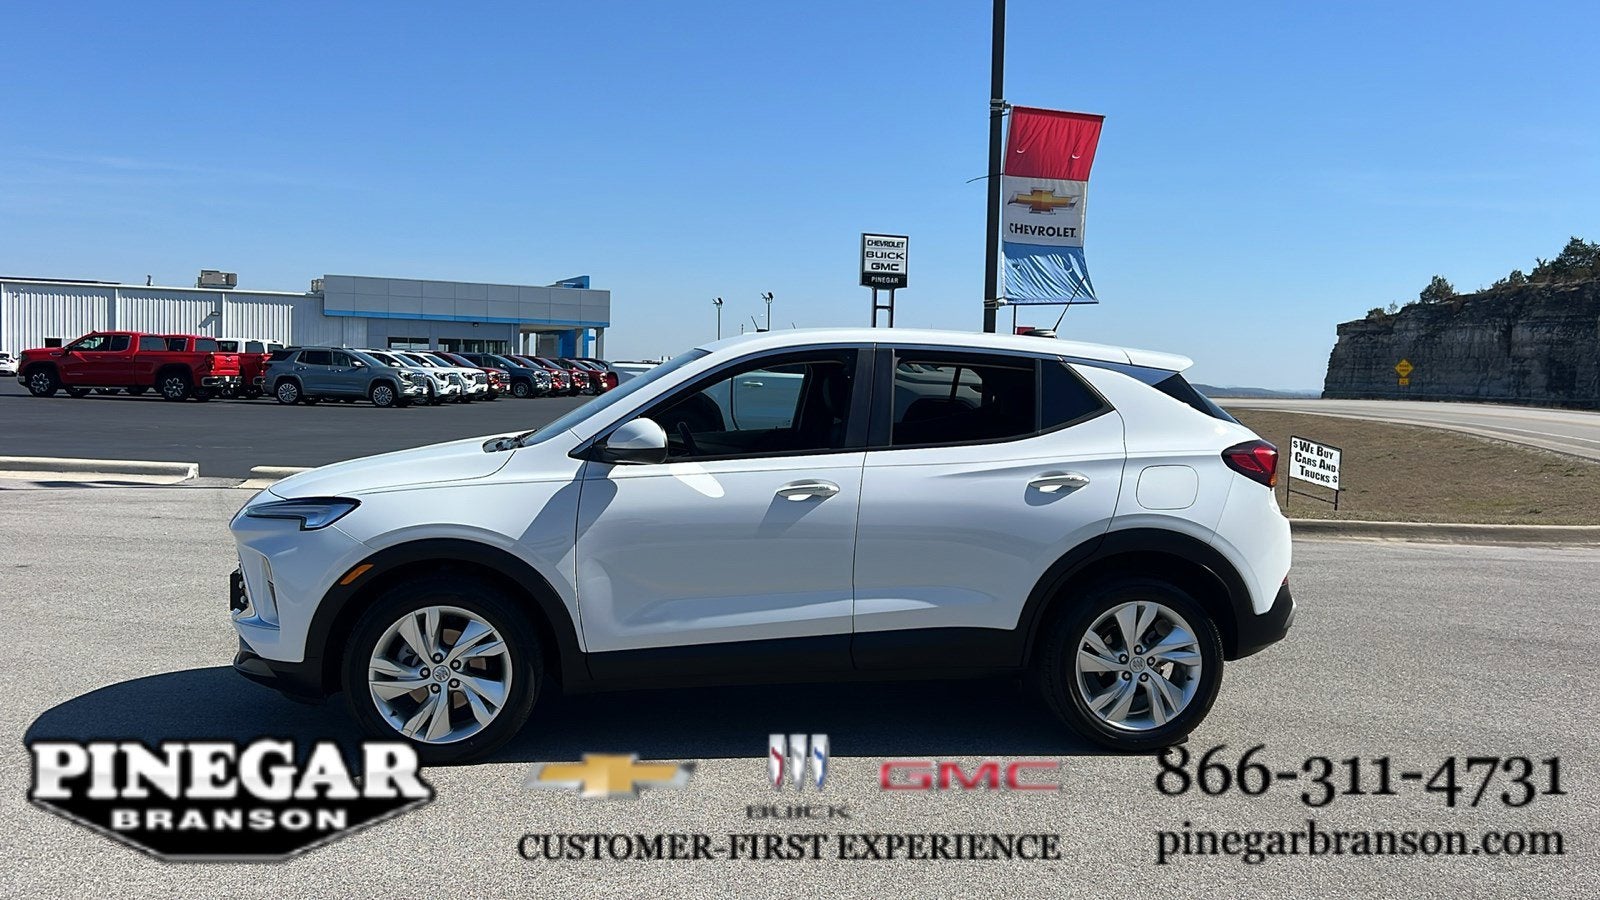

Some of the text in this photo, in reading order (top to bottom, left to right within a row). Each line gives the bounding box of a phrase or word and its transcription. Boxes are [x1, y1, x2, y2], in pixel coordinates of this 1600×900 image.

[867, 239, 905, 249] CHEVROLET
[866, 250, 905, 260] BUICK
[870, 262, 900, 271] GMC
[871, 276, 899, 284] PINEGAR
